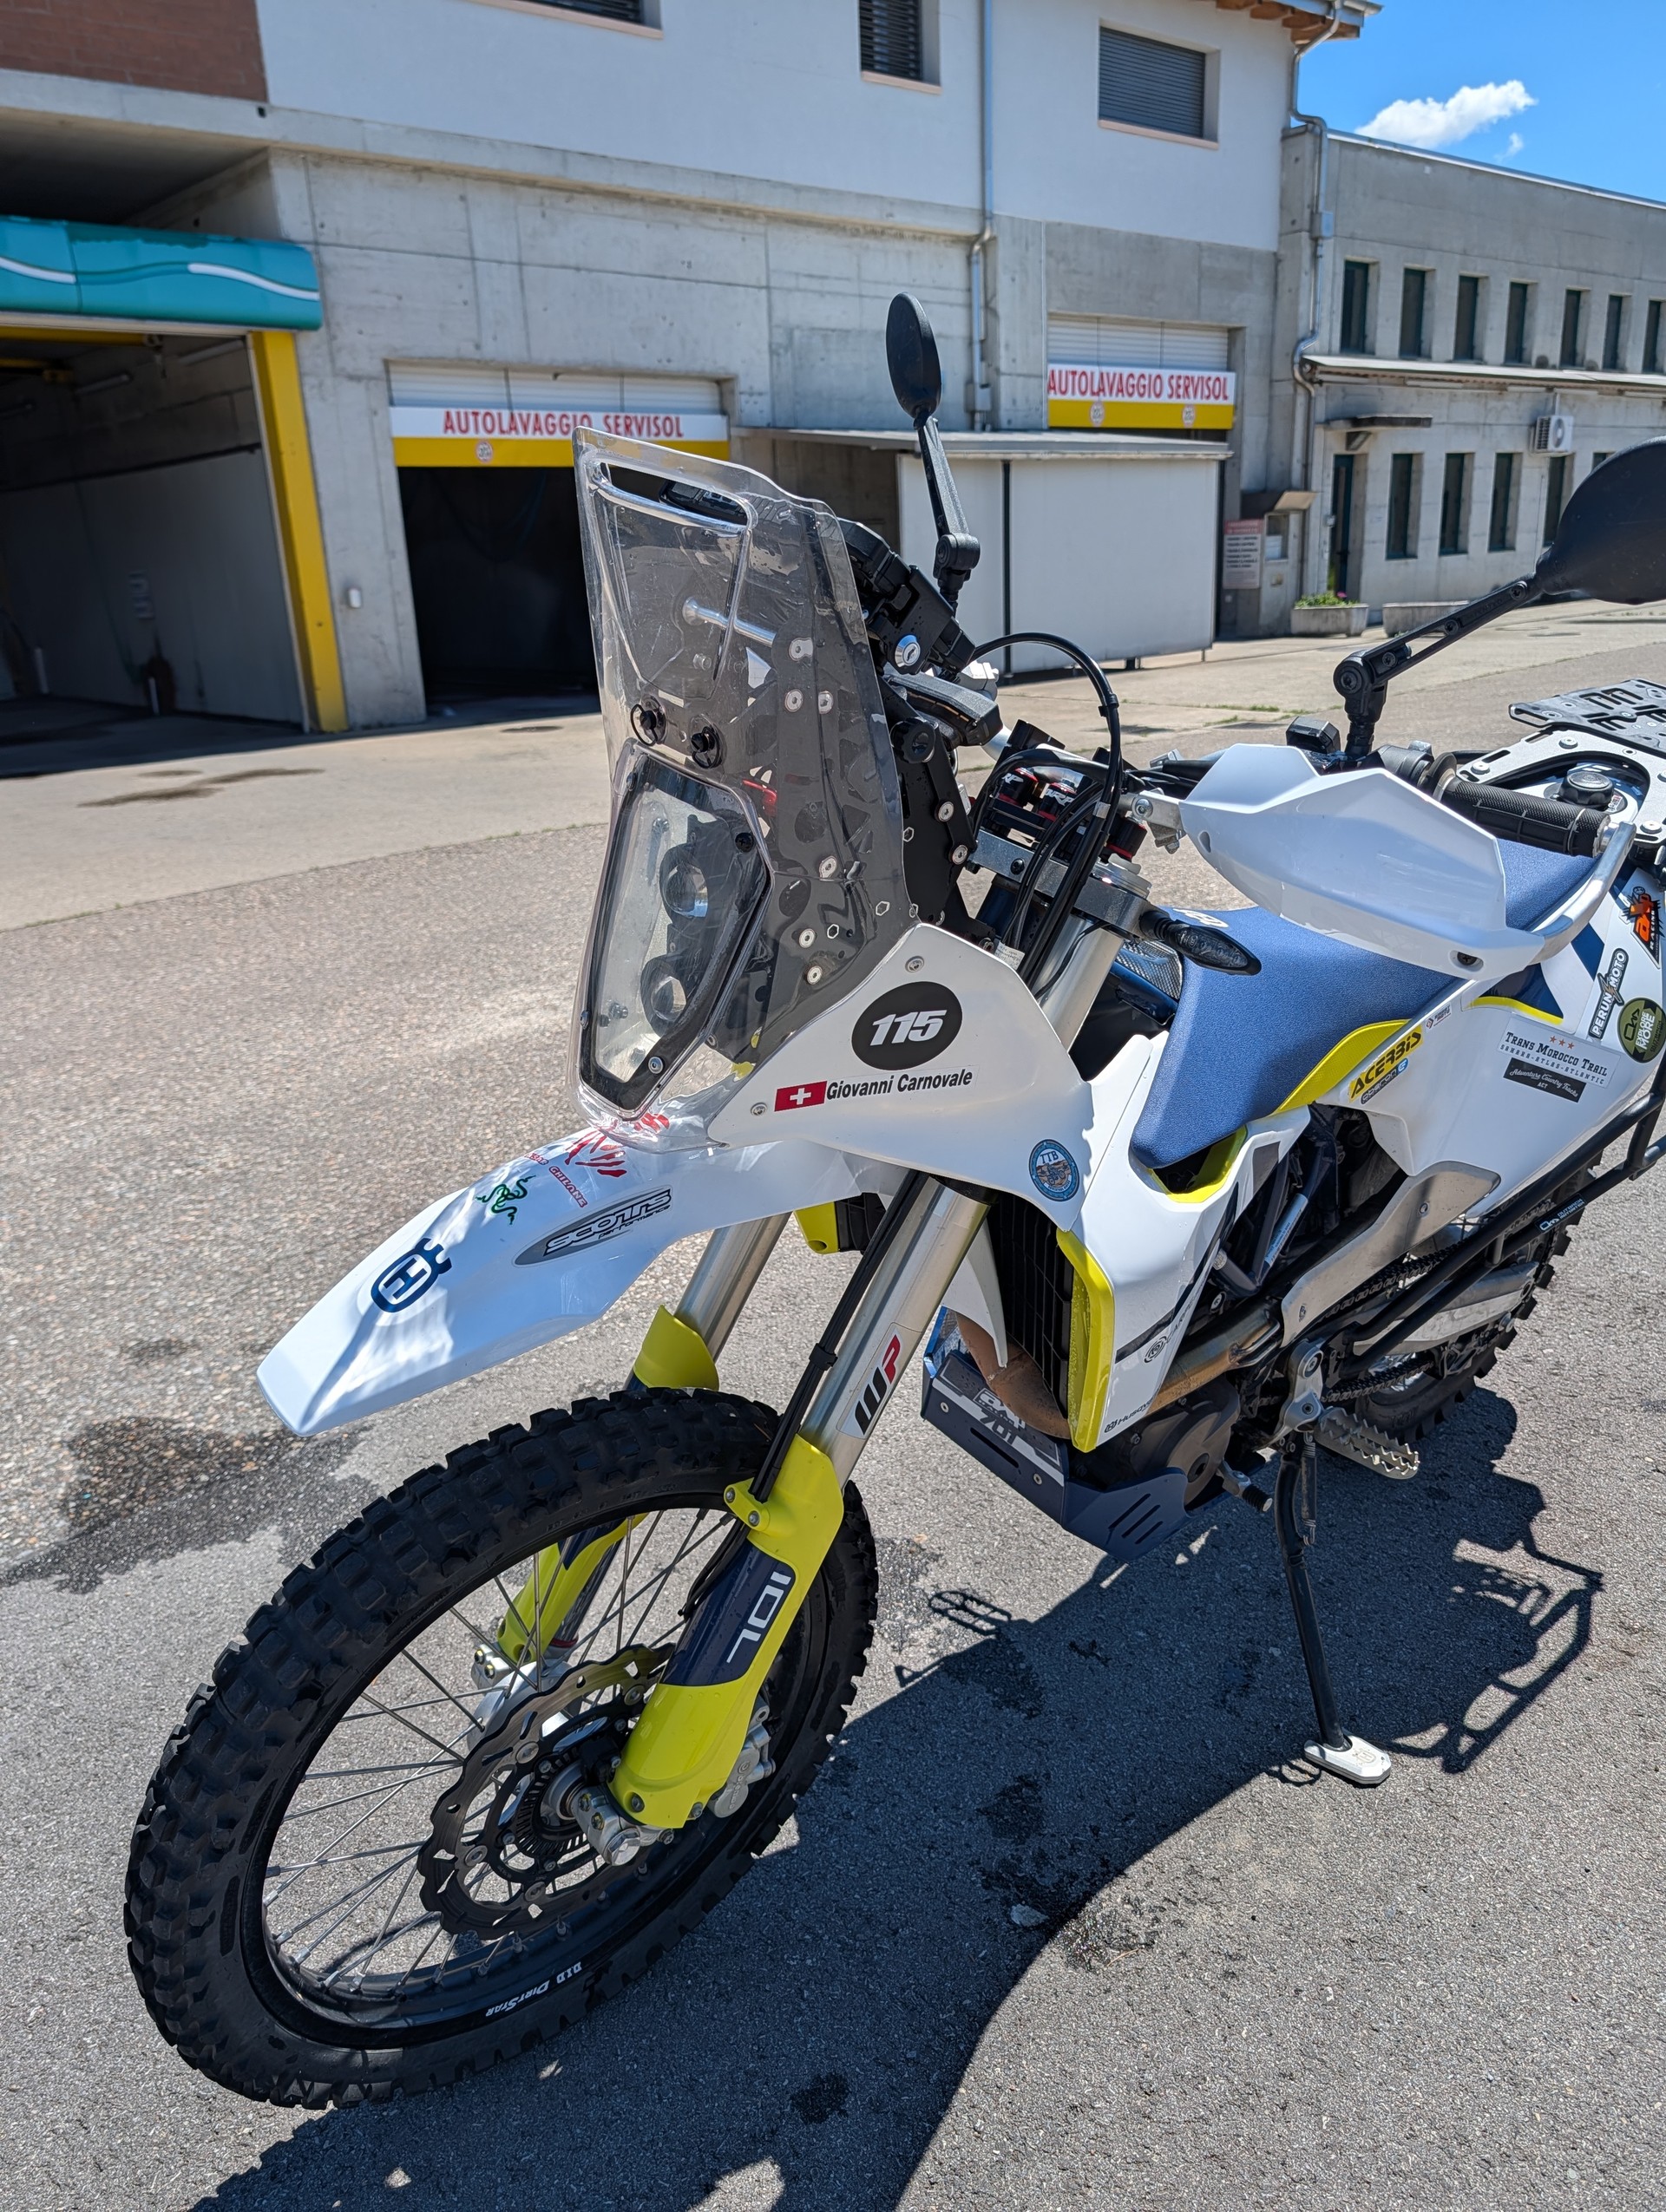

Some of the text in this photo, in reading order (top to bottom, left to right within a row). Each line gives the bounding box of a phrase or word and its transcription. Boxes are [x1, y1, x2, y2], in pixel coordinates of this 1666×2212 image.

[1047, 370, 1229, 401] AUTOLAVAGGIO SERVISOL
[443, 409, 684, 438] AUTOLAVAGGIO SERVISOL
[1592, 951, 1626, 1037] PERUN MOTO
[869, 1010, 947, 1046] 115
[1636, 1011, 1650, 1046] EXPLORE
[1637, 1014, 1656, 1050] MORE
[826, 1069, 973, 1100] Giovanni Carnovale
[1510, 1068, 1578, 1098] Adventure Country Tracks
[1040, 1150, 1059, 1164] TTB
[543, 1188, 672, 1257] SCOTTS
[598, 1204, 671, 1240] performance
[980, 1414, 1018, 1446] 701
